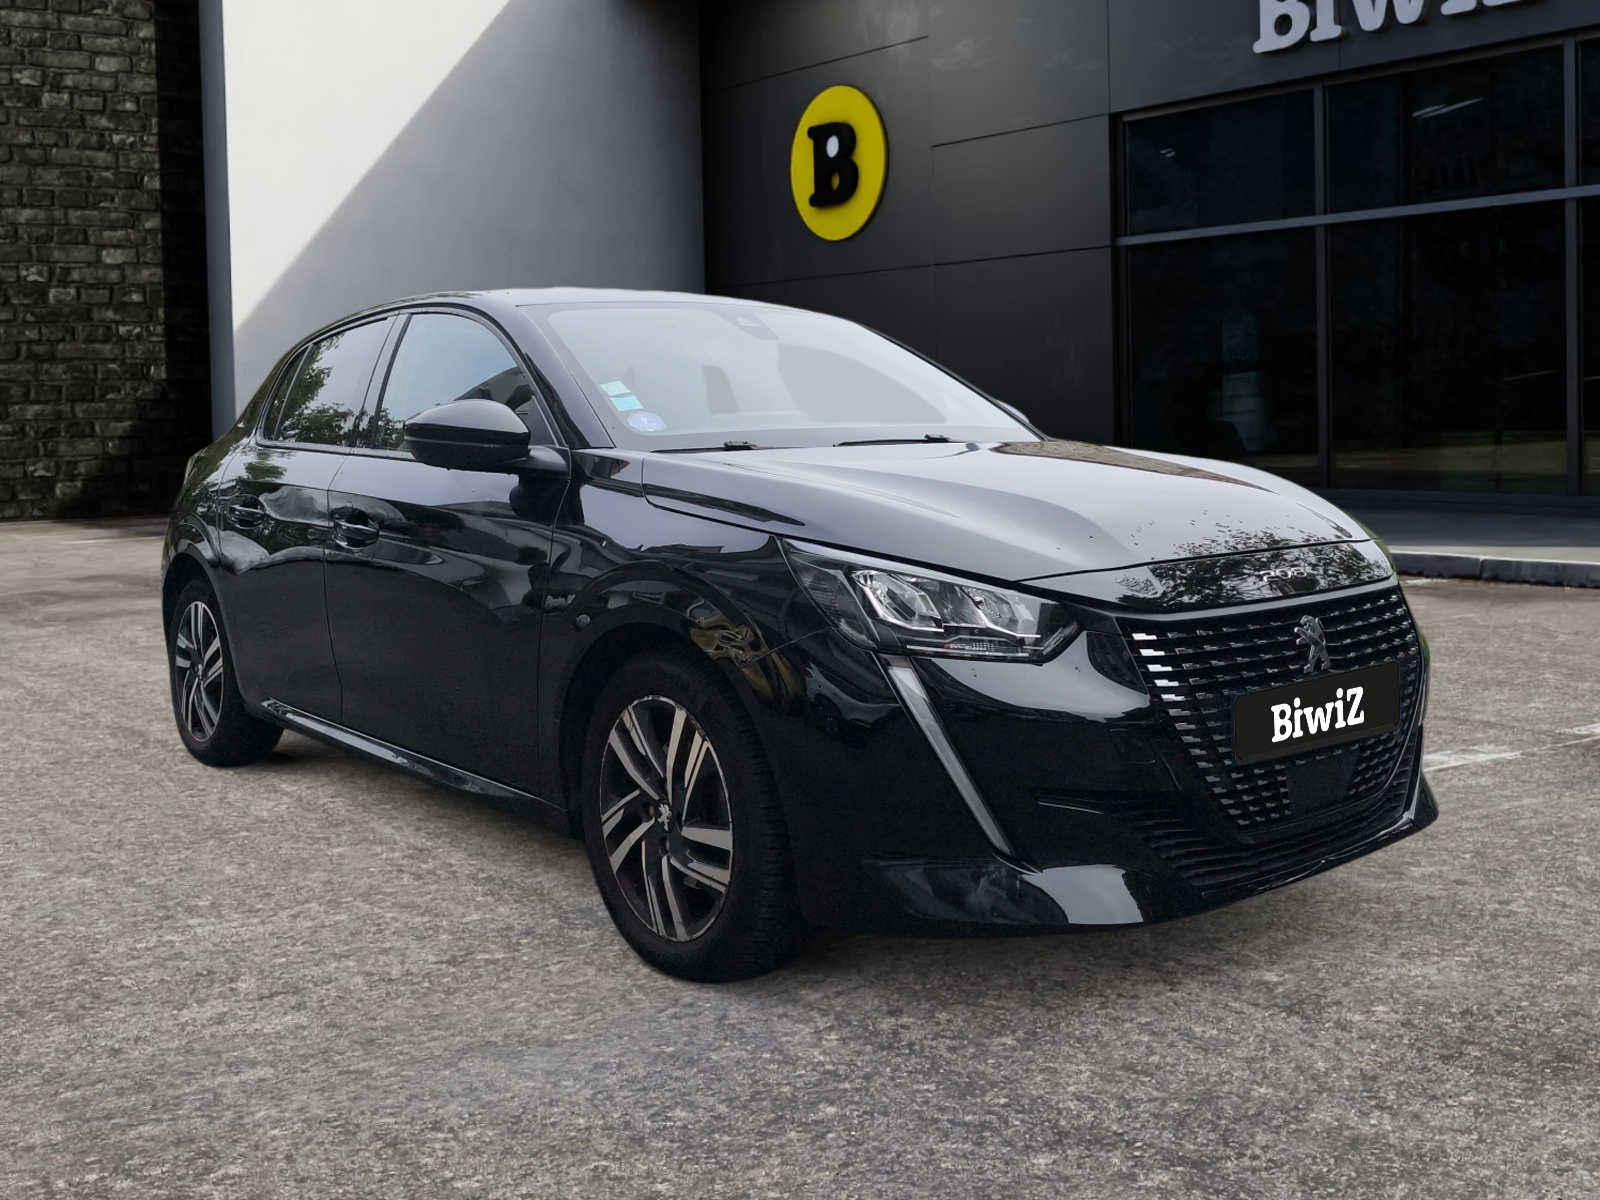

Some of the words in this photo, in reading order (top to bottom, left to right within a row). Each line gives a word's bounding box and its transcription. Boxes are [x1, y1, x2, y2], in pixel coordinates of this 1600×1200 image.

[807, 121, 859, 208] B
[1260, 567, 1307, 583] 208
[1270, 686, 1365, 743] BiwiZ
